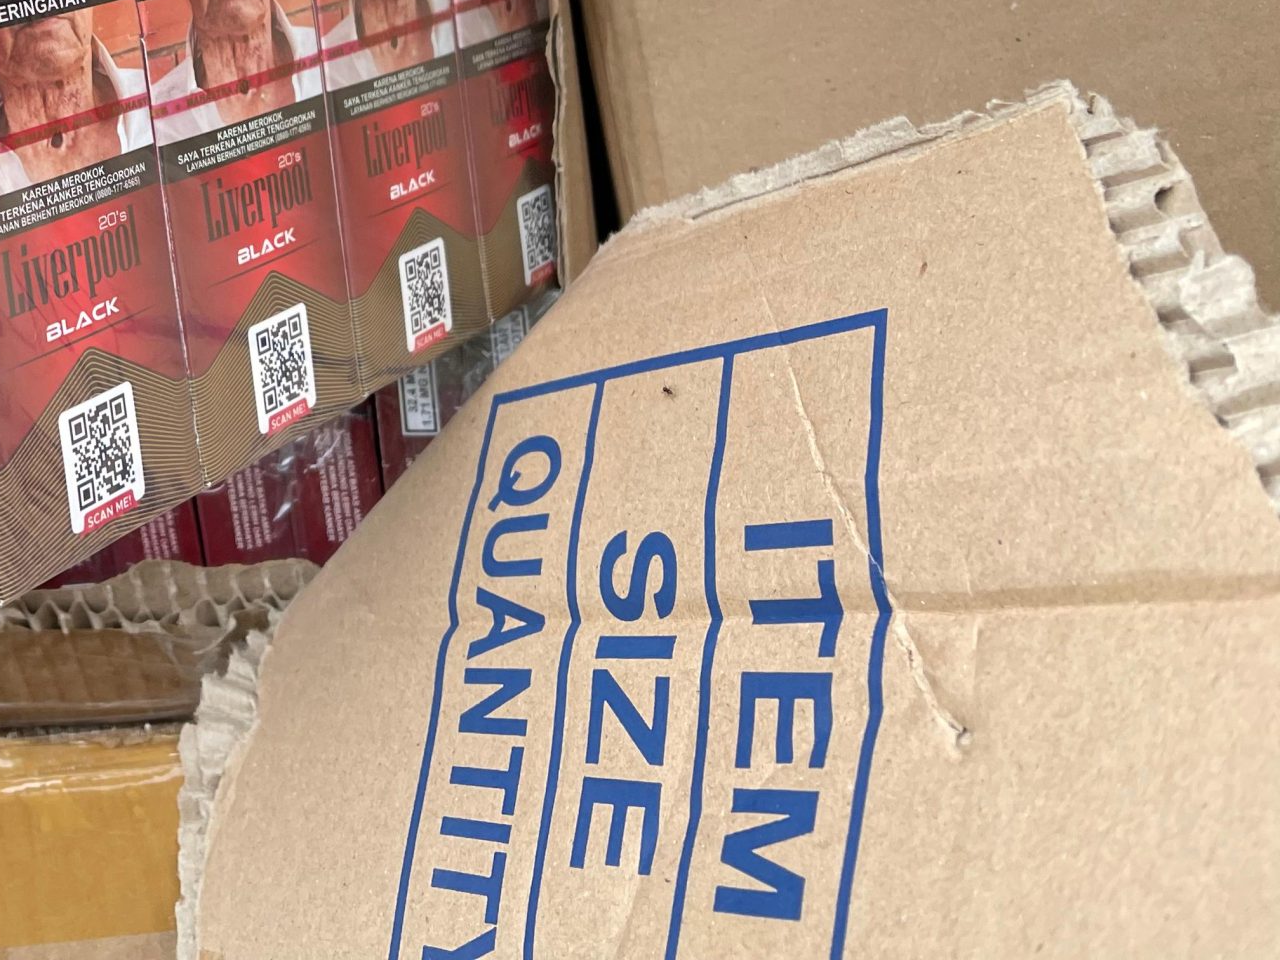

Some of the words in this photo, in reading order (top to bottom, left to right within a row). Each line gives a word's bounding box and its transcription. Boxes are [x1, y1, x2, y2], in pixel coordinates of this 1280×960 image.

[343, 95, 361, 108] SAYA
[177, 152, 199, 165] SAYA
[200, 141, 236, 158] TERKENA
[237, 130, 265, 146] KANKER
[267, 110, 315, 135] TENGGOROKAN
[217, 125, 248, 141] KARENA
[249, 111, 283, 131] MEROKOK
[362, 99, 448, 178] Liverpool
[508, 123, 542, 149] BLACK
[186, 157, 216, 173] LAYANAN
[217, 147, 246, 163] BERHENTI
[247, 137, 275, 153] MEROKOK
[278, 152, 301, 169] 20's
[0, 200, 45, 222] TERKENA
[47, 186, 83, 207] KANKER
[84, 162, 146, 193] TENGGOROKAN
[22, 181, 60, 202] KARENA
[61, 165, 105, 189] MEROKOK
[200, 145, 313, 243] Liverpool
[390, 169, 436, 200] BLACK
[21, 206, 58, 227] BERHENTI
[59, 194, 94, 213] MEROKOK
[98, 210, 127, 231] 20's
[1, 203, 141, 319] Liverpool
[237, 227, 296, 265] BLACK
[46, 296, 120, 342] BLACK
[405, 388, 418, 412] 32.4
[417, 377, 429, 398] MG
[272, 410, 292, 430] SCAN
[293, 403, 306, 417] ME!
[88, 505, 113, 528] SCAN
[116, 495, 132, 512] ME!
[569, 530, 678, 876] SIZE
[712, 518, 845, 921] ITEM
